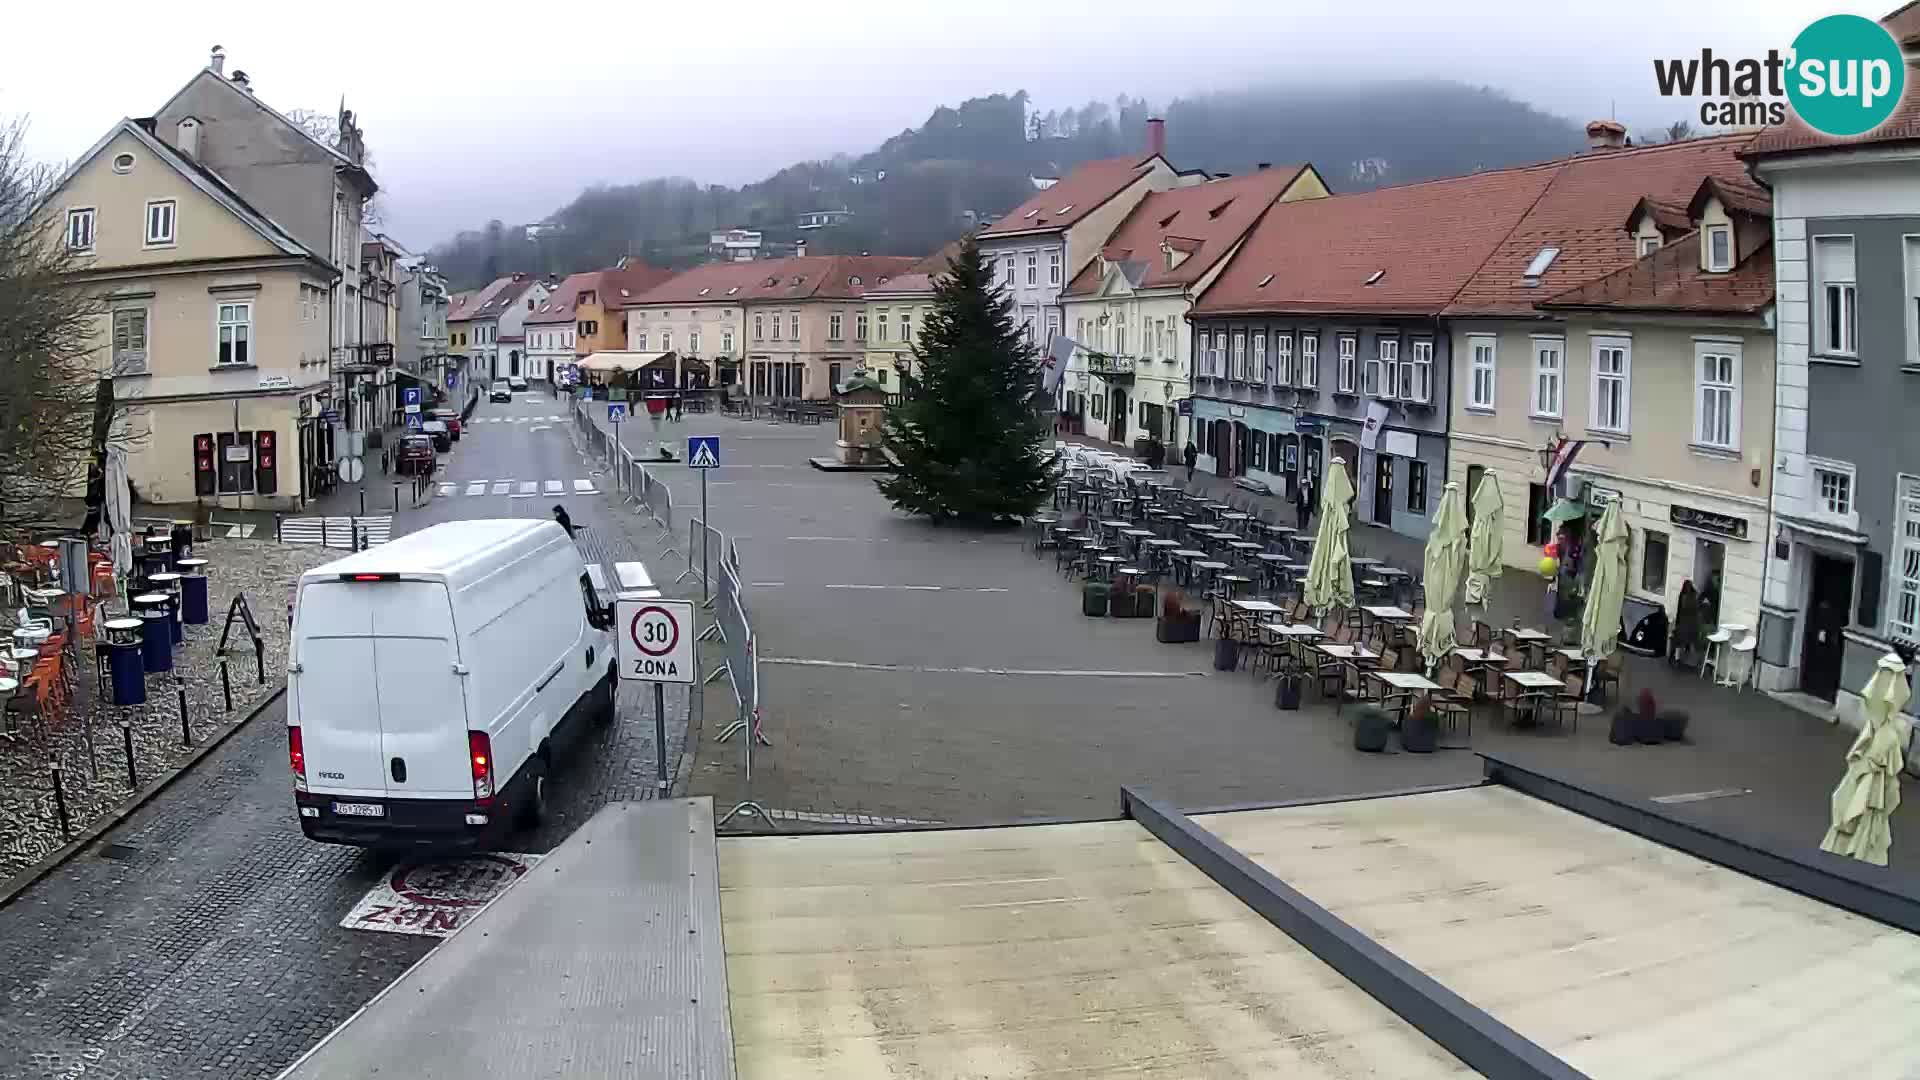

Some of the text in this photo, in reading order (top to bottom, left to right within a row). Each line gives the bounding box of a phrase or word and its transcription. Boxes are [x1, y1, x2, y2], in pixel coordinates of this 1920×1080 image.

[643, 622, 668, 643] 30
[633, 659, 678, 677] ZONA
[360, 904, 461, 930] ZON
